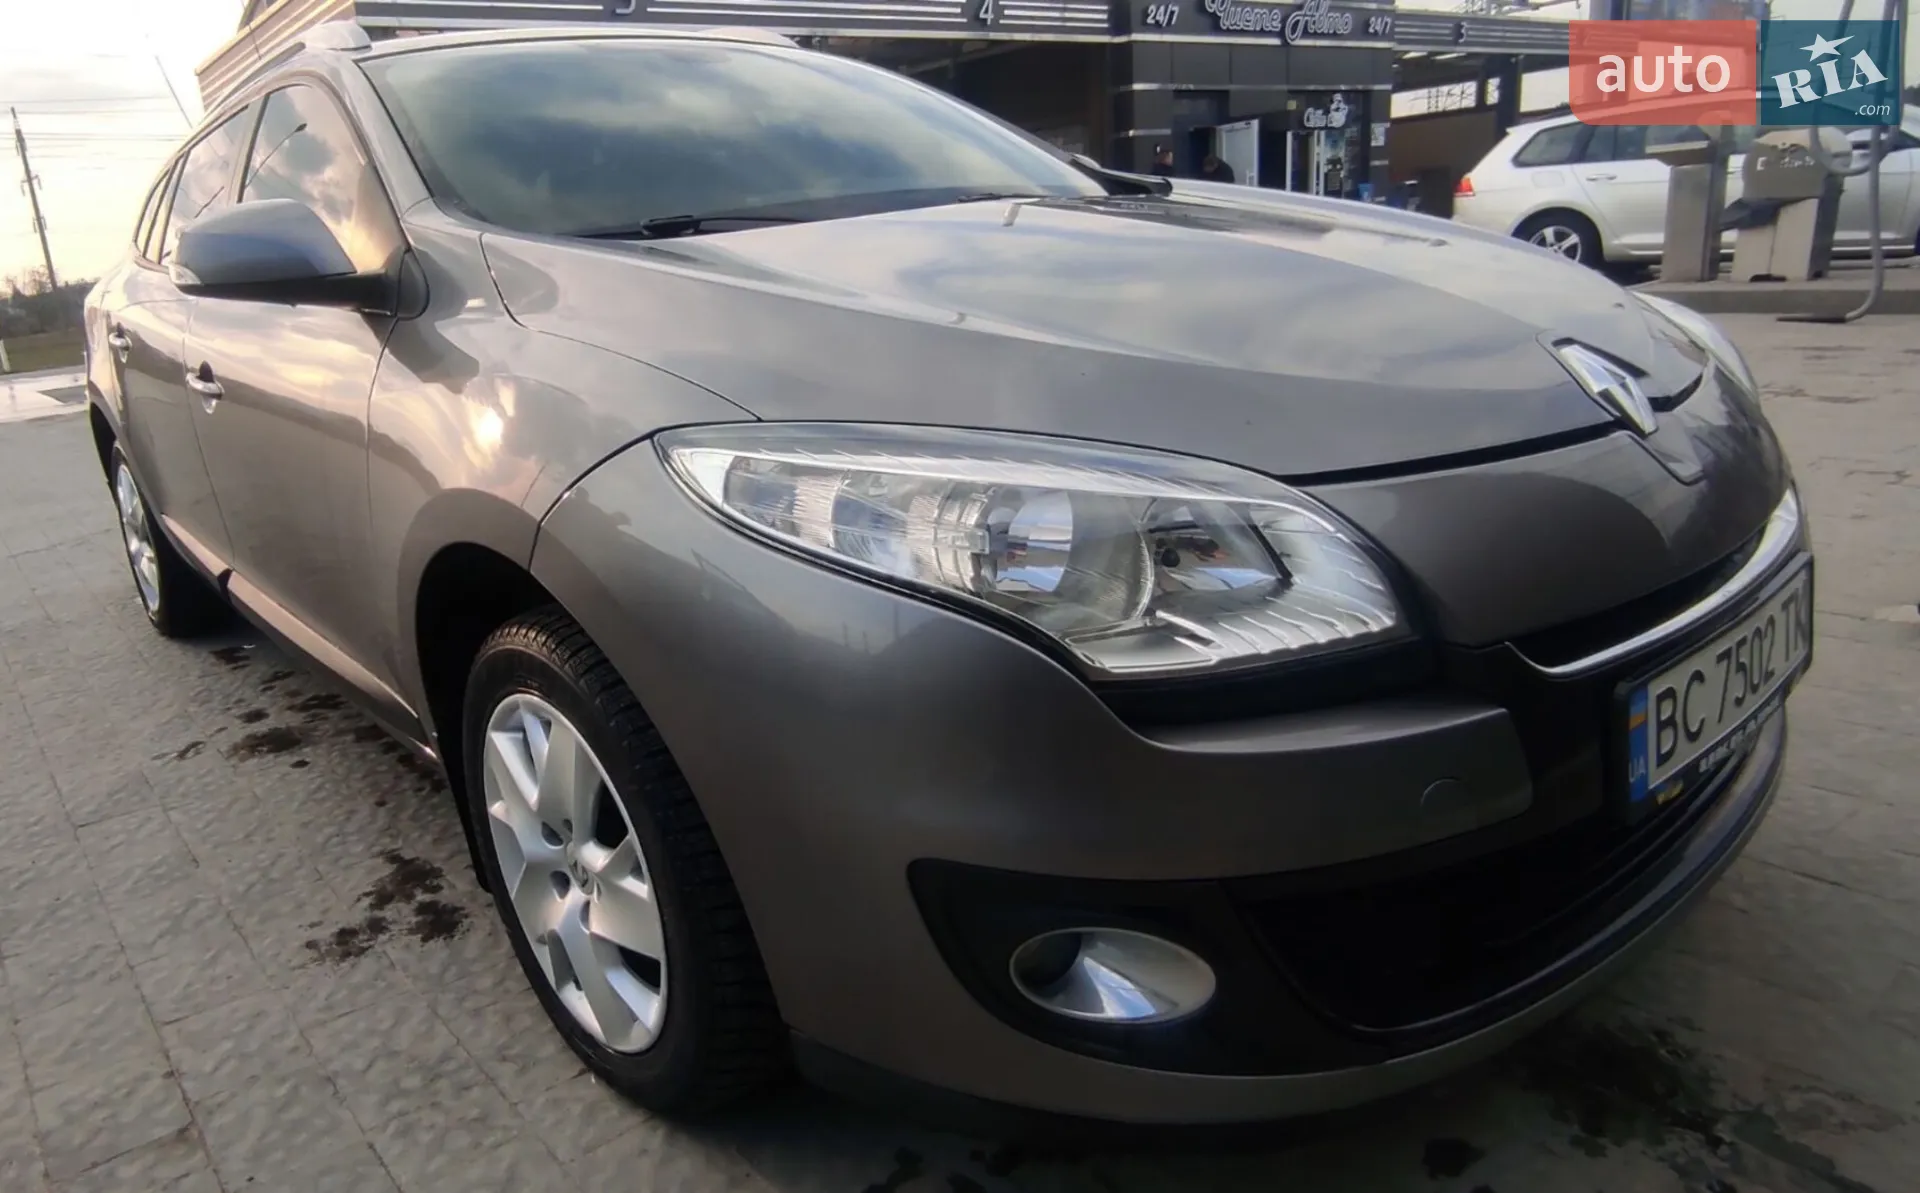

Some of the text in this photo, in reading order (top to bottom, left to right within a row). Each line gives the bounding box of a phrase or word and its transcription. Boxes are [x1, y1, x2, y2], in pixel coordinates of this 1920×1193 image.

[979, 0, 994, 25] 4
[1146, 4, 1179, 28] 24/7
[1368, 16, 1392, 36] 24/7
[1655, 668, 1706, 769] BC
[1716, 614, 1776, 724] 7502
[1628, 756, 1646, 784] UA
